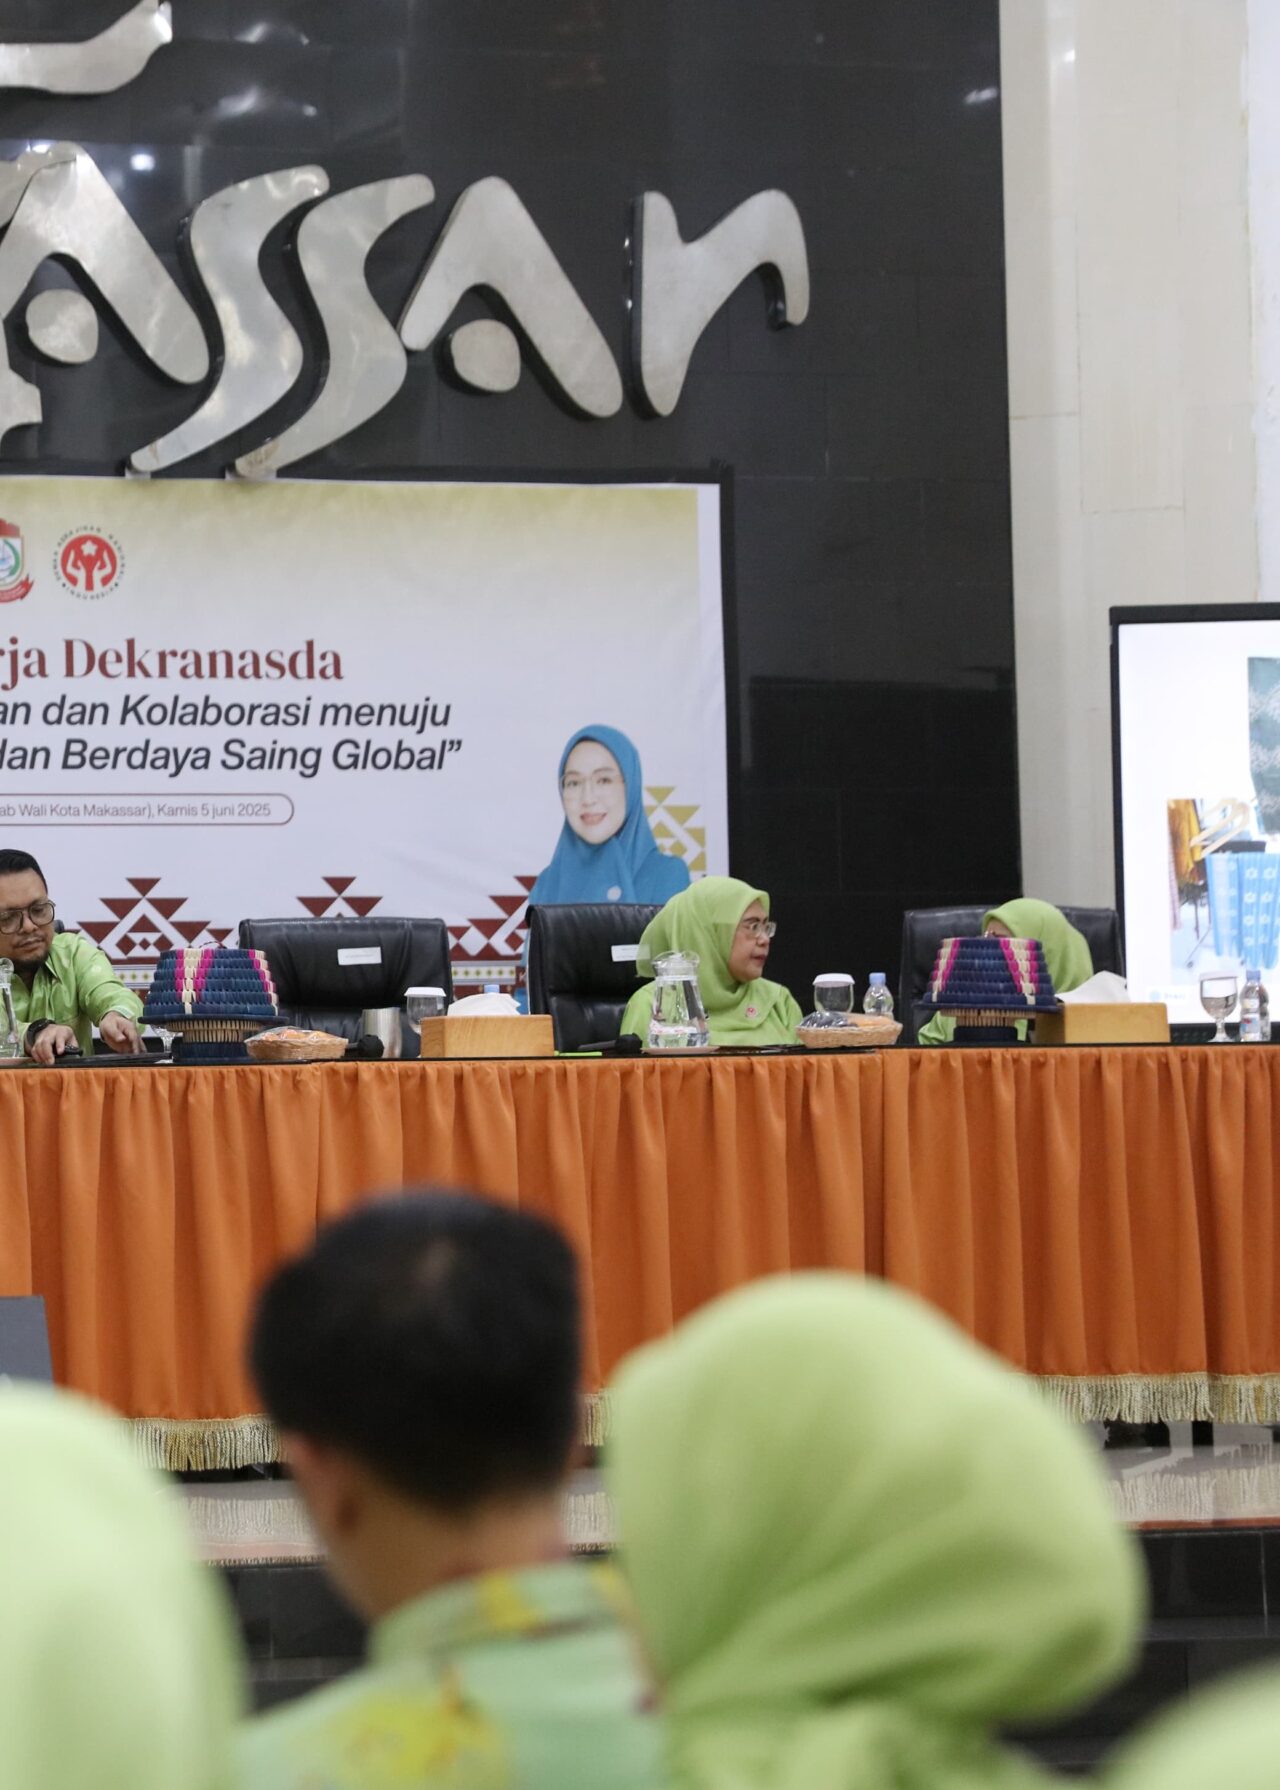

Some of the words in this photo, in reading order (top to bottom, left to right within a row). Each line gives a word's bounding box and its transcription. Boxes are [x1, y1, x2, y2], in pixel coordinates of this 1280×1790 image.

[64, 637, 344, 681] Dekranasda
[41, 693, 110, 726] dan
[119, 694, 312, 727] Kolaborasi
[319, 696, 452, 734] menuju
[61, 738, 212, 779] Berdaya
[220, 738, 323, 779] Saing
[19, 803, 48, 817] Wali
[50, 803, 81, 817] Kota
[83, 803, 155, 820] Makassar),
[156, 803, 199, 817] Kamis
[201, 803, 210, 817] 5
[212, 803, 235, 820] juni
[237, 803, 271, 817] 2025
